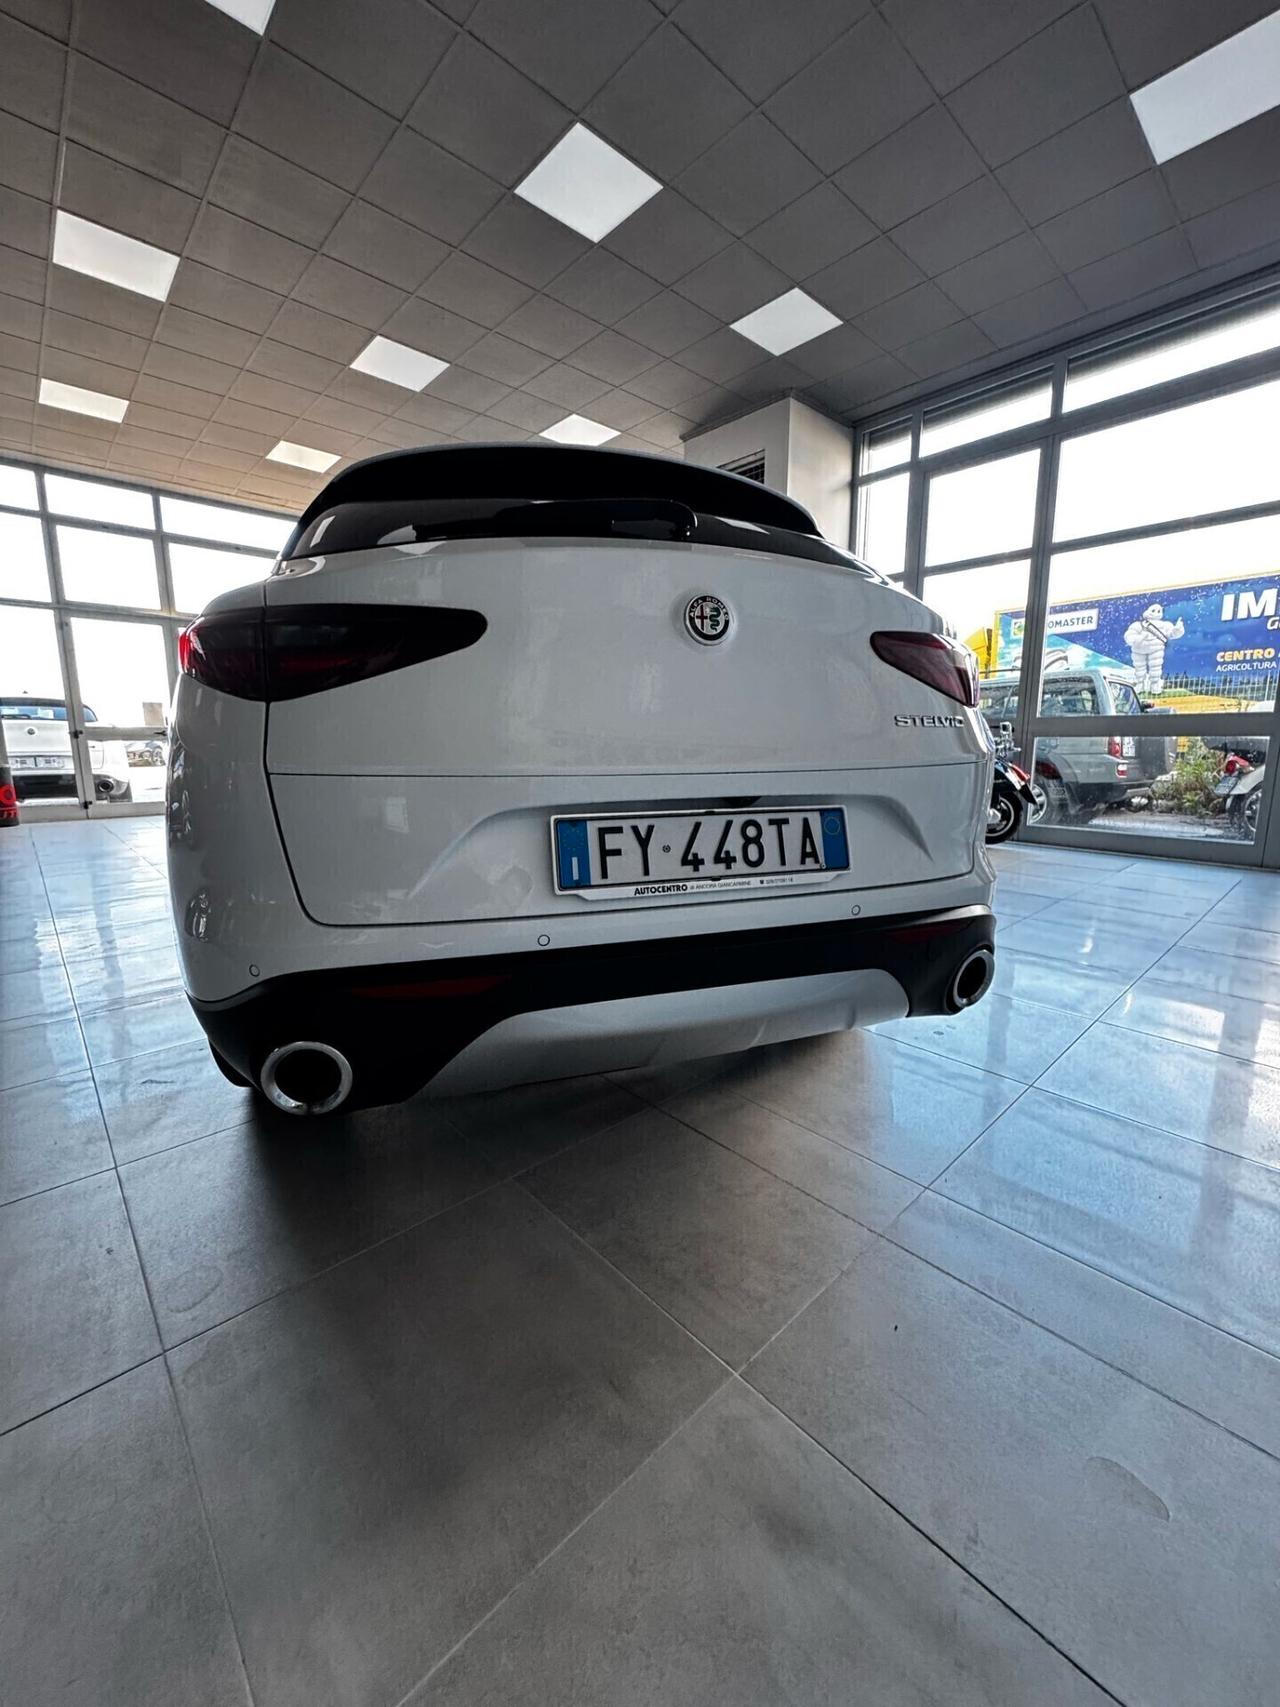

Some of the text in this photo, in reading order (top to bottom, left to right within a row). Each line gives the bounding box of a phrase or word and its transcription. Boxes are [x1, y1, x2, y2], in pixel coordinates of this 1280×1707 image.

[1047, 616, 1094, 629] OMASTER
[1266, 616, 1280, 631] G
[1216, 648, 1275, 662] CENTRO
[1216, 660, 1277, 672] AGRICOLTURA
[894, 714, 964, 728] STELVIO
[598, 817, 820, 879] FY 448TA
[634, 884, 688, 895] AUTOCENTRO
